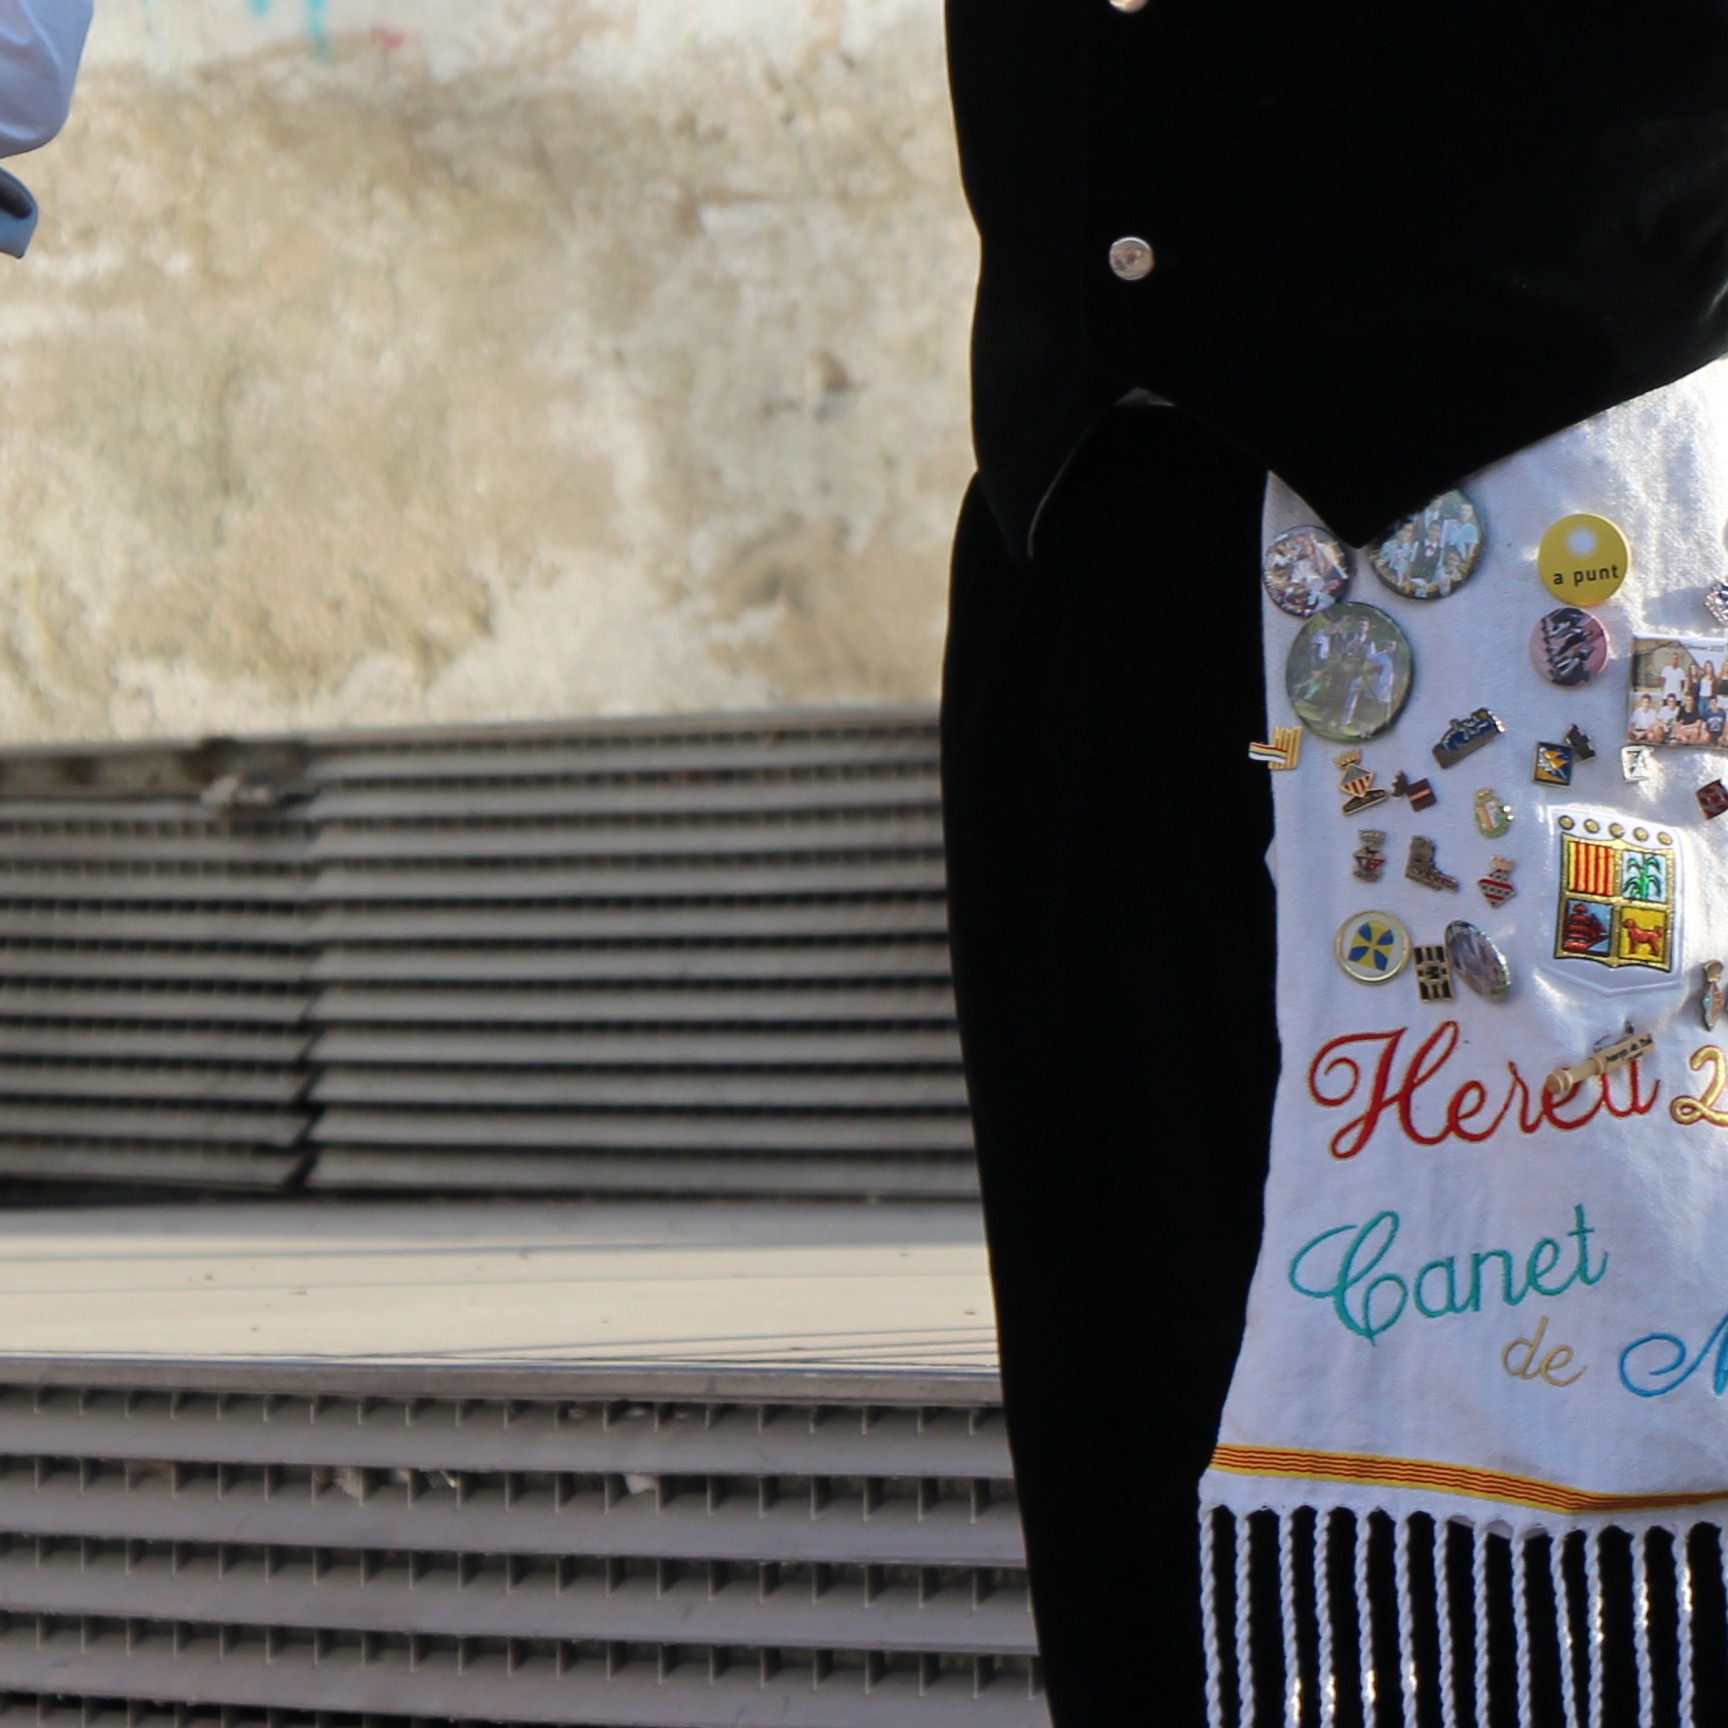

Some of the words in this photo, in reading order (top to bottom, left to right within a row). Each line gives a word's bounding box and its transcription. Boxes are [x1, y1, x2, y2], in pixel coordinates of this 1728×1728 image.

[1553, 572, 1564, 585] a
[1573, 563, 1619, 588] punt
[1308, 1020, 1661, 1160] Hereu
[1288, 1203, 1610, 1346] Canet
[1502, 1315, 1588, 1388] de
